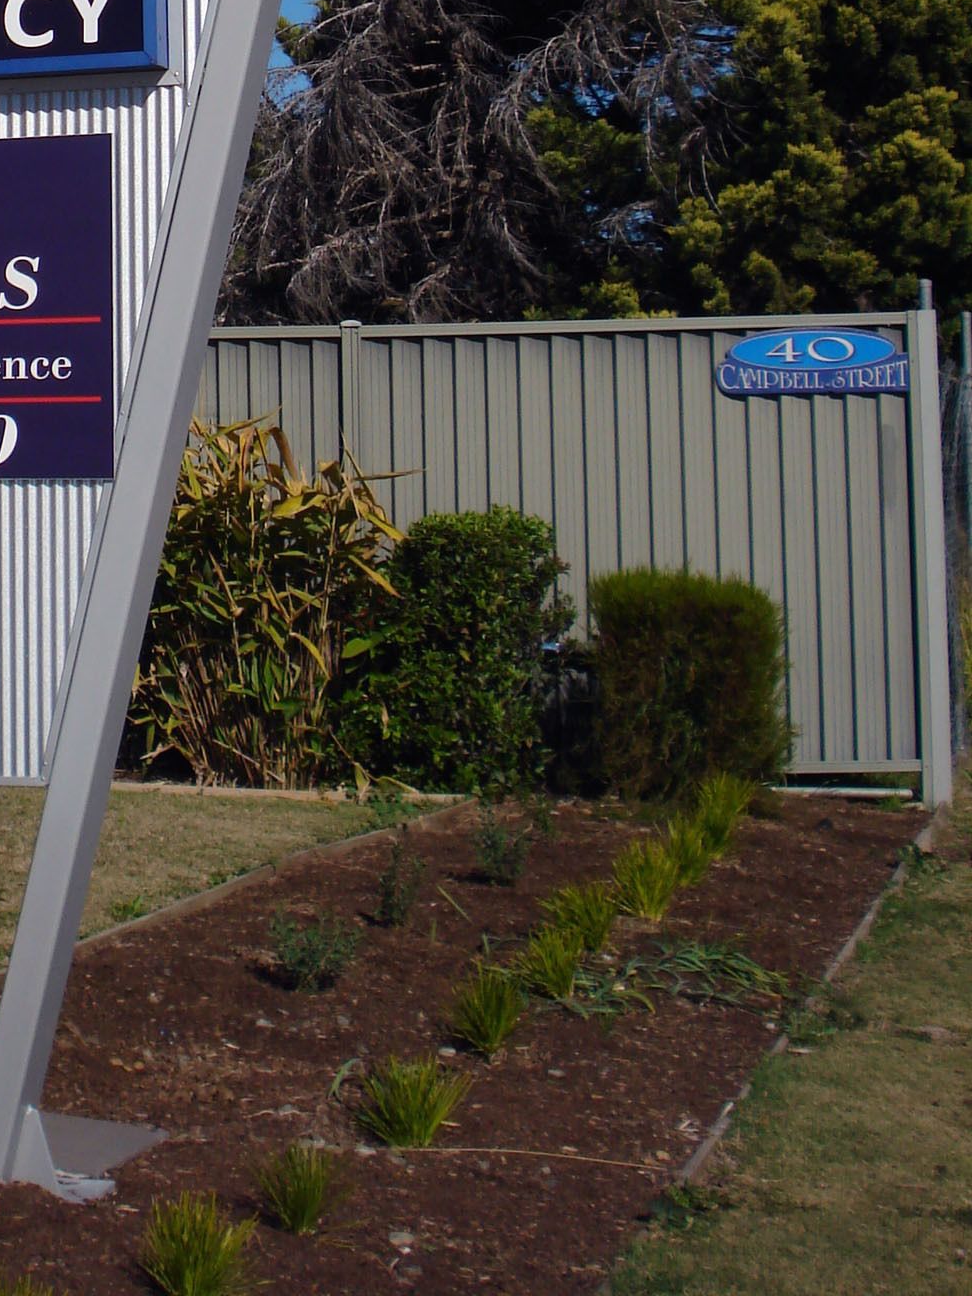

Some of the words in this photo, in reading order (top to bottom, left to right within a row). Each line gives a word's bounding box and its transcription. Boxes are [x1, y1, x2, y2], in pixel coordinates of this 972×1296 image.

[765, 336, 855, 363] 40
[719, 364, 824, 389] CAMPBELL
[831, 360, 908, 388] STREET
